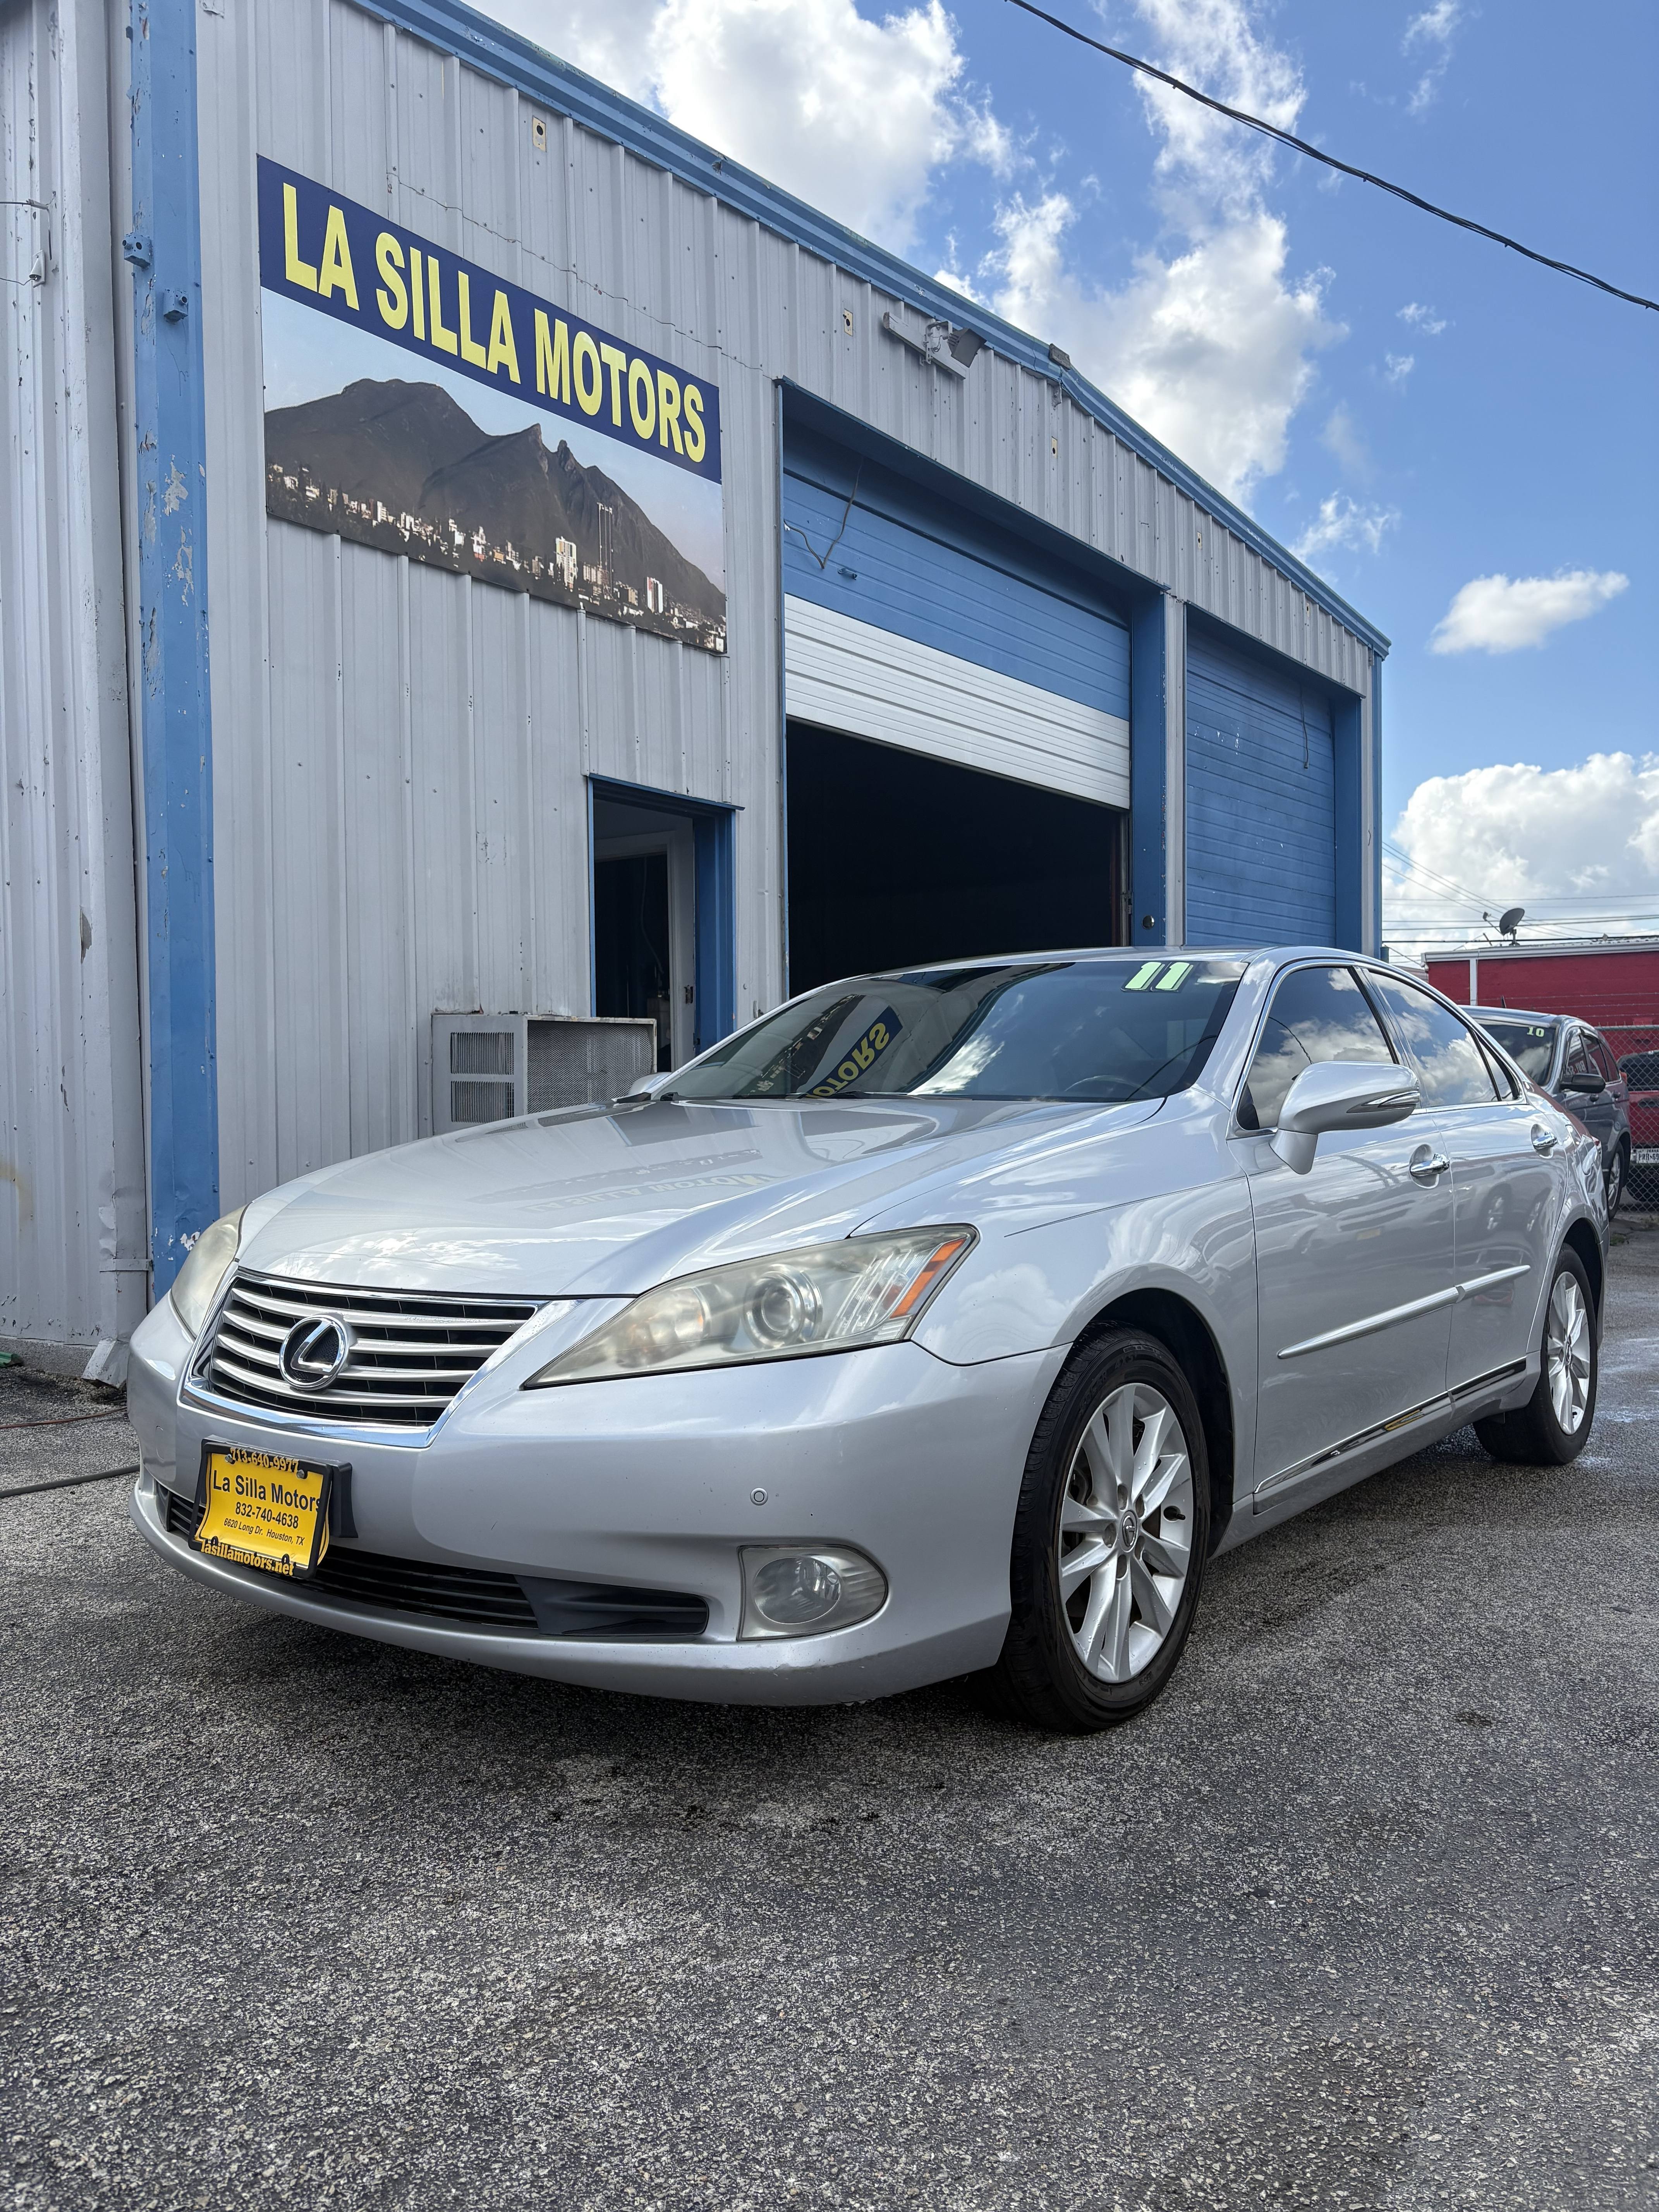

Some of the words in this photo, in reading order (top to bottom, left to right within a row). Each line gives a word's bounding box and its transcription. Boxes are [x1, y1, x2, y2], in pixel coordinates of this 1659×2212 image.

[283, 183, 359, 311] LA
[375, 232, 520, 384] SILLA
[534, 308, 705, 463] MOTORS
[1125, 962, 1194, 990] 11
[1527, 1026, 1544, 1037] 10
[230, 1447, 299, 1473] 713-640-9977
[213, 1470, 230, 1492] La
[235, 1475, 266, 1501] Silla
[235, 1501, 299, 1529] 832-740-4638
[224, 1518, 238, 1528] 6620
[238, 1522, 254, 1535] Long
[255, 1525, 263, 1535] Dr.
[266, 1528, 294, 1545] Houston,
[295, 1535, 305, 1546] TX
[201, 1539, 294, 1576] lasillamotors.net
